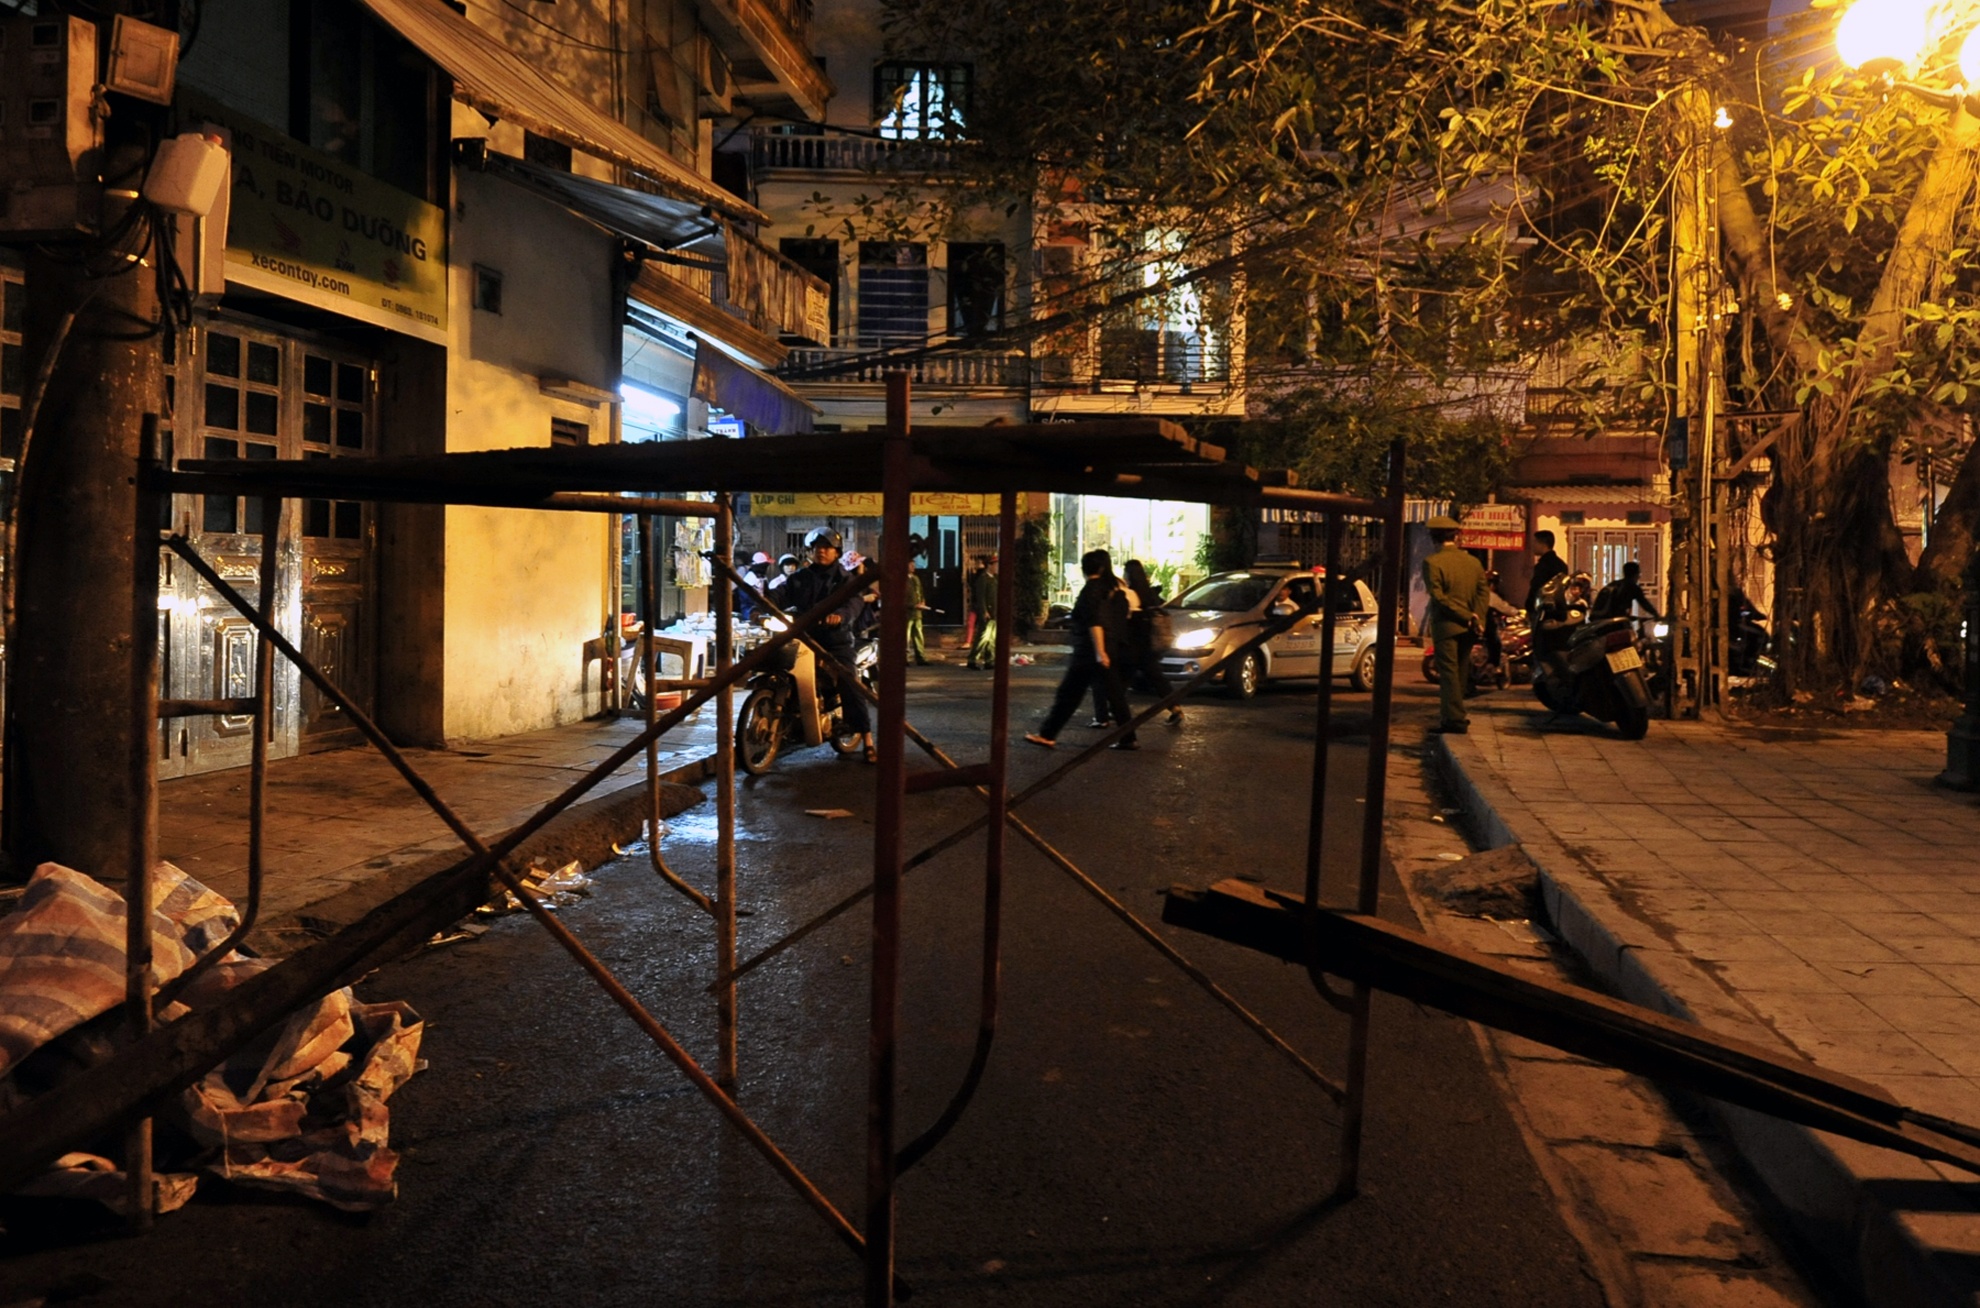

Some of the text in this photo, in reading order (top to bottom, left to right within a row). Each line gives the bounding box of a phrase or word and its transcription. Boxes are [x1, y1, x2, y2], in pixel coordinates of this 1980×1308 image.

[301, 158, 354, 195] MOTOR
[276, 178, 334, 222] BẢO
[342, 206, 427, 262] DƯỠNG
[251, 251, 350, 295] xecontay.com
